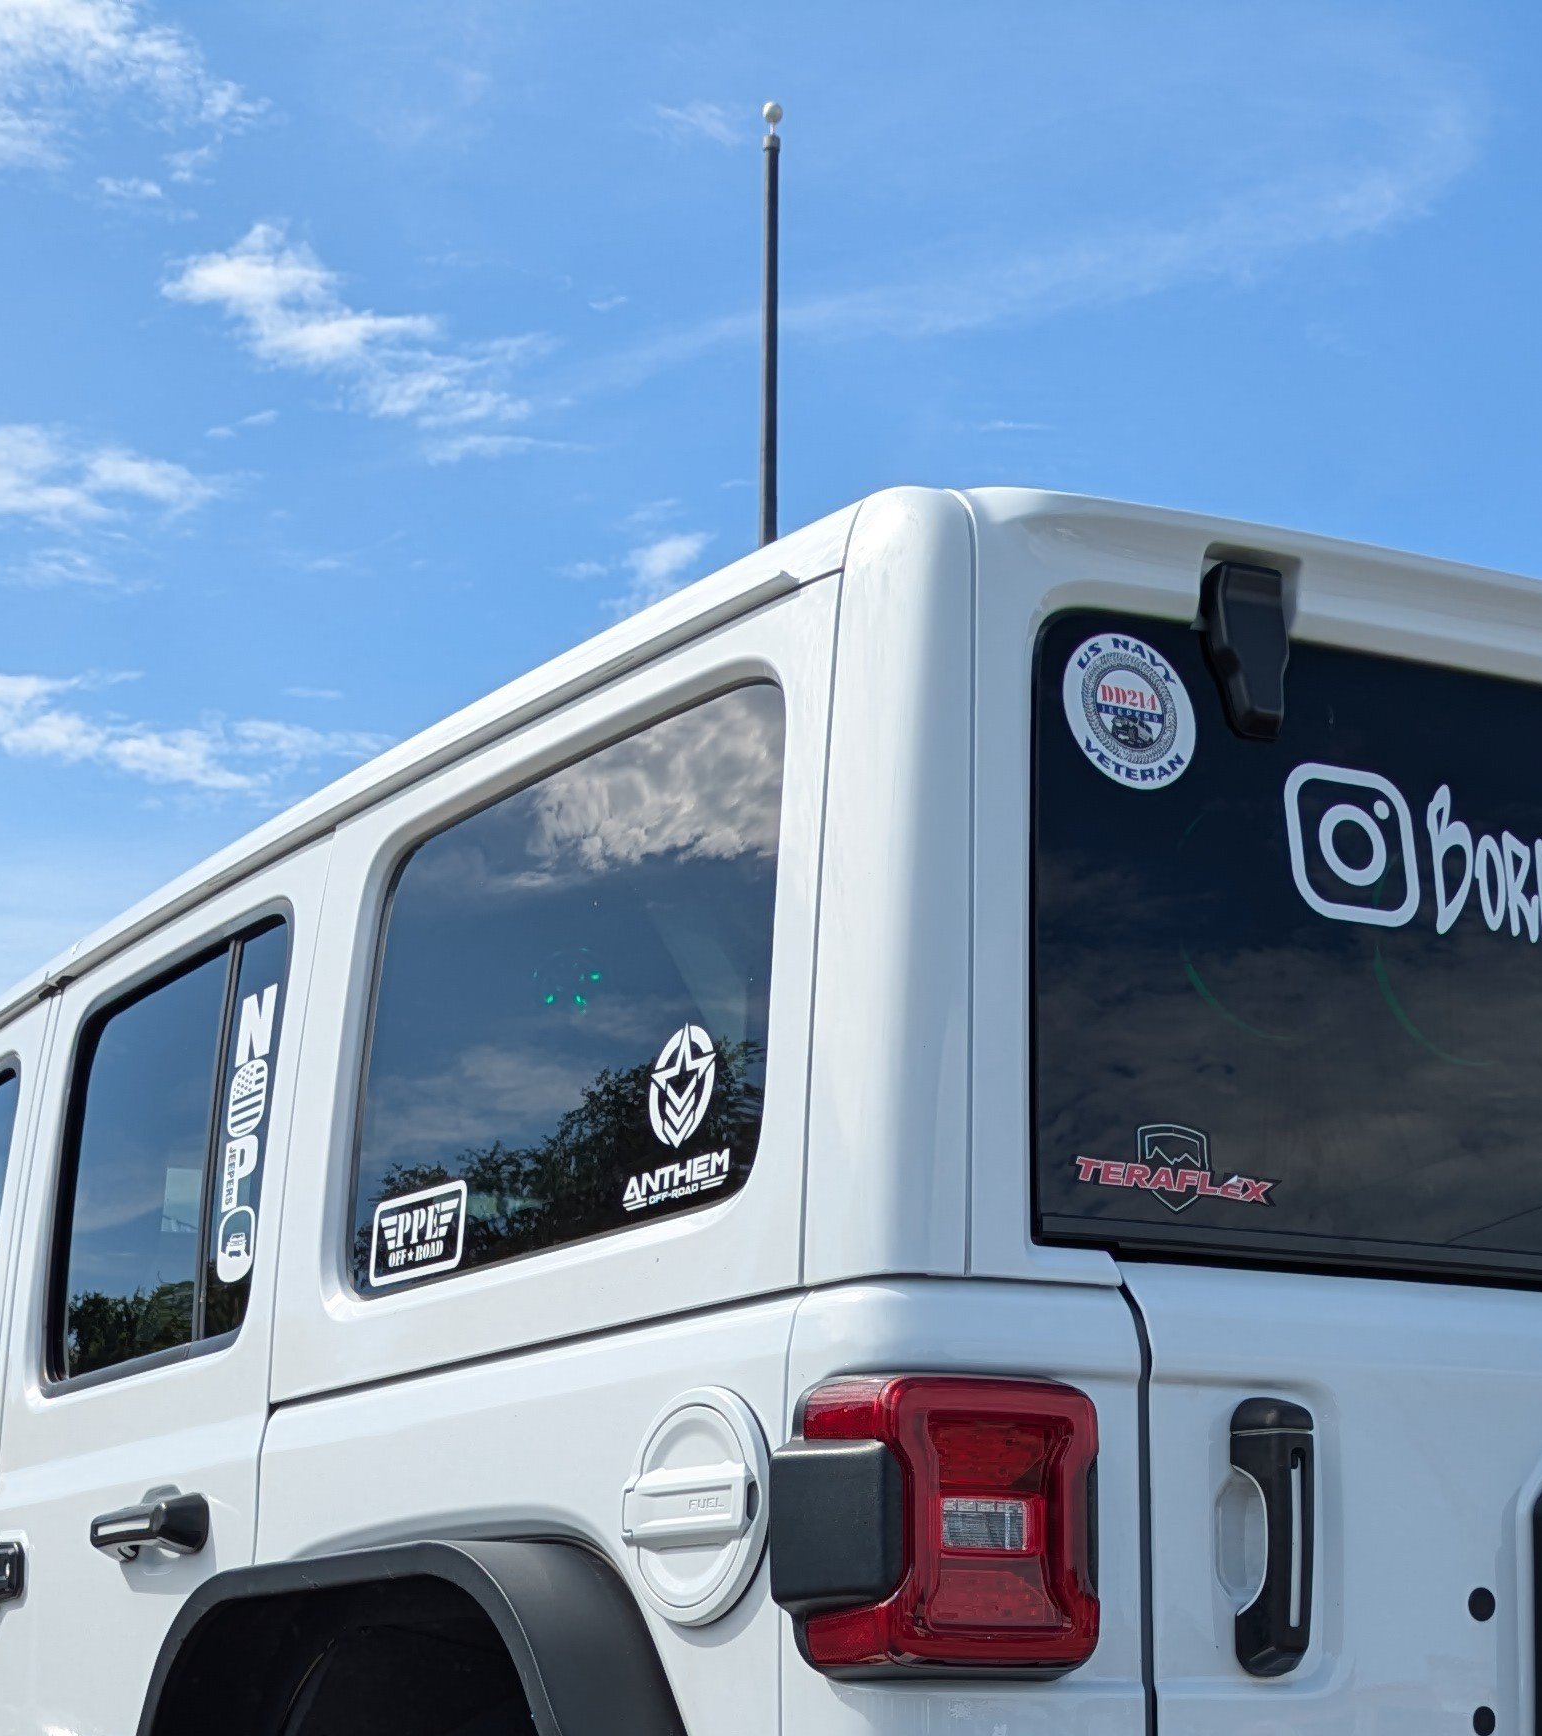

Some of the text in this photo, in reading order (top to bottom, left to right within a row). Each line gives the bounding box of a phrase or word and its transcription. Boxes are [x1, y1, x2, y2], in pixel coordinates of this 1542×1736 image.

[1076, 636, 1177, 685] US NAVY
[1100, 684, 1158, 711] DD214
[1084, 735, 1186, 782] VETERAN
[224, 1145, 238, 1206] JEEPERS
[622, 1147, 731, 1202] ANTHEM
[647, 1182, 700, 1205] OFF-ROAD
[1075, 1155, 1274, 1206] TERAFLEX
[395, 1202, 441, 1248] PPE
[687, 1496, 725, 1513] FUEL
